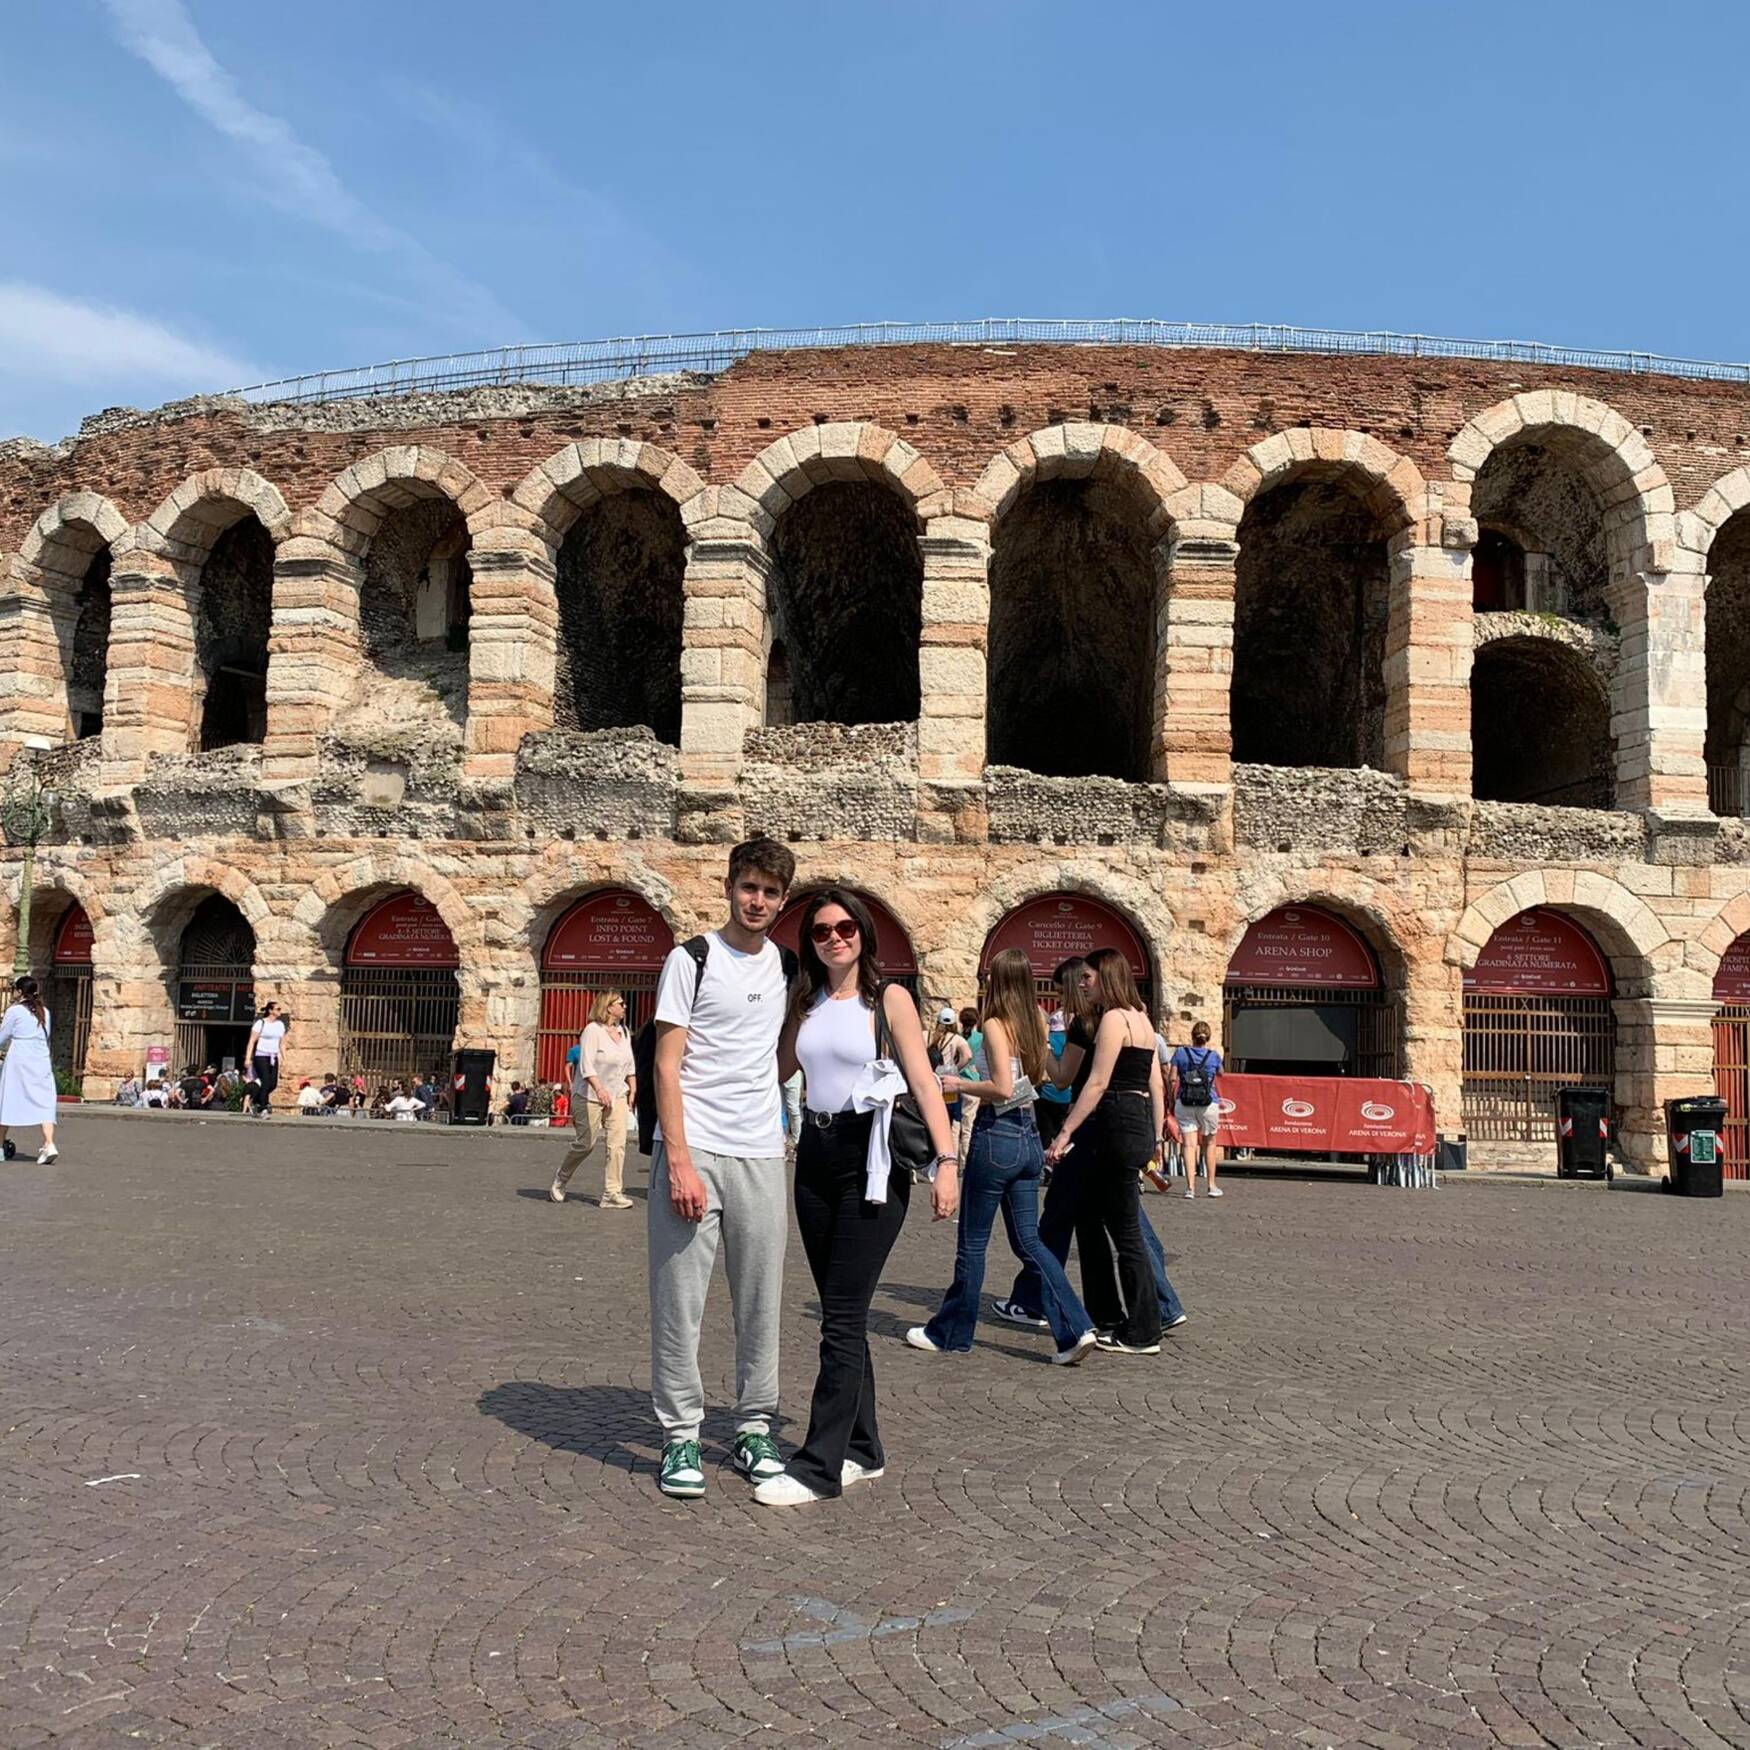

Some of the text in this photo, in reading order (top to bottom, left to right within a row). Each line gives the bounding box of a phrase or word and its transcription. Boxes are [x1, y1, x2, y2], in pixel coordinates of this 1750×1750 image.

[596, 924, 648, 933] INFO POINT
[1027, 921, 1066, 929] Cancello
[1075, 922, 1095, 930] Gate
[589, 934, 610, 943] LOST
[622, 934, 655, 943] FOUND
[1033, 930, 1093, 939] BIGLIETTERIA
[1257, 932, 1288, 941] Entrata
[1298, 933, 1319, 942] Gate
[1321, 934, 1331, 942] 10
[1494, 935, 1523, 943] Entrata
[1532, 936, 1552, 944] Gate
[1032, 940, 1095, 950] TICKET OFFICE
[1255, 946, 1333, 958] ARENA SHOP
[1477, 959, 1577, 969] GRADINATA NUMERATA
[1300, 1127, 1327, 1135] VERONA
[1380, 1130, 1407, 1138] VERONA
